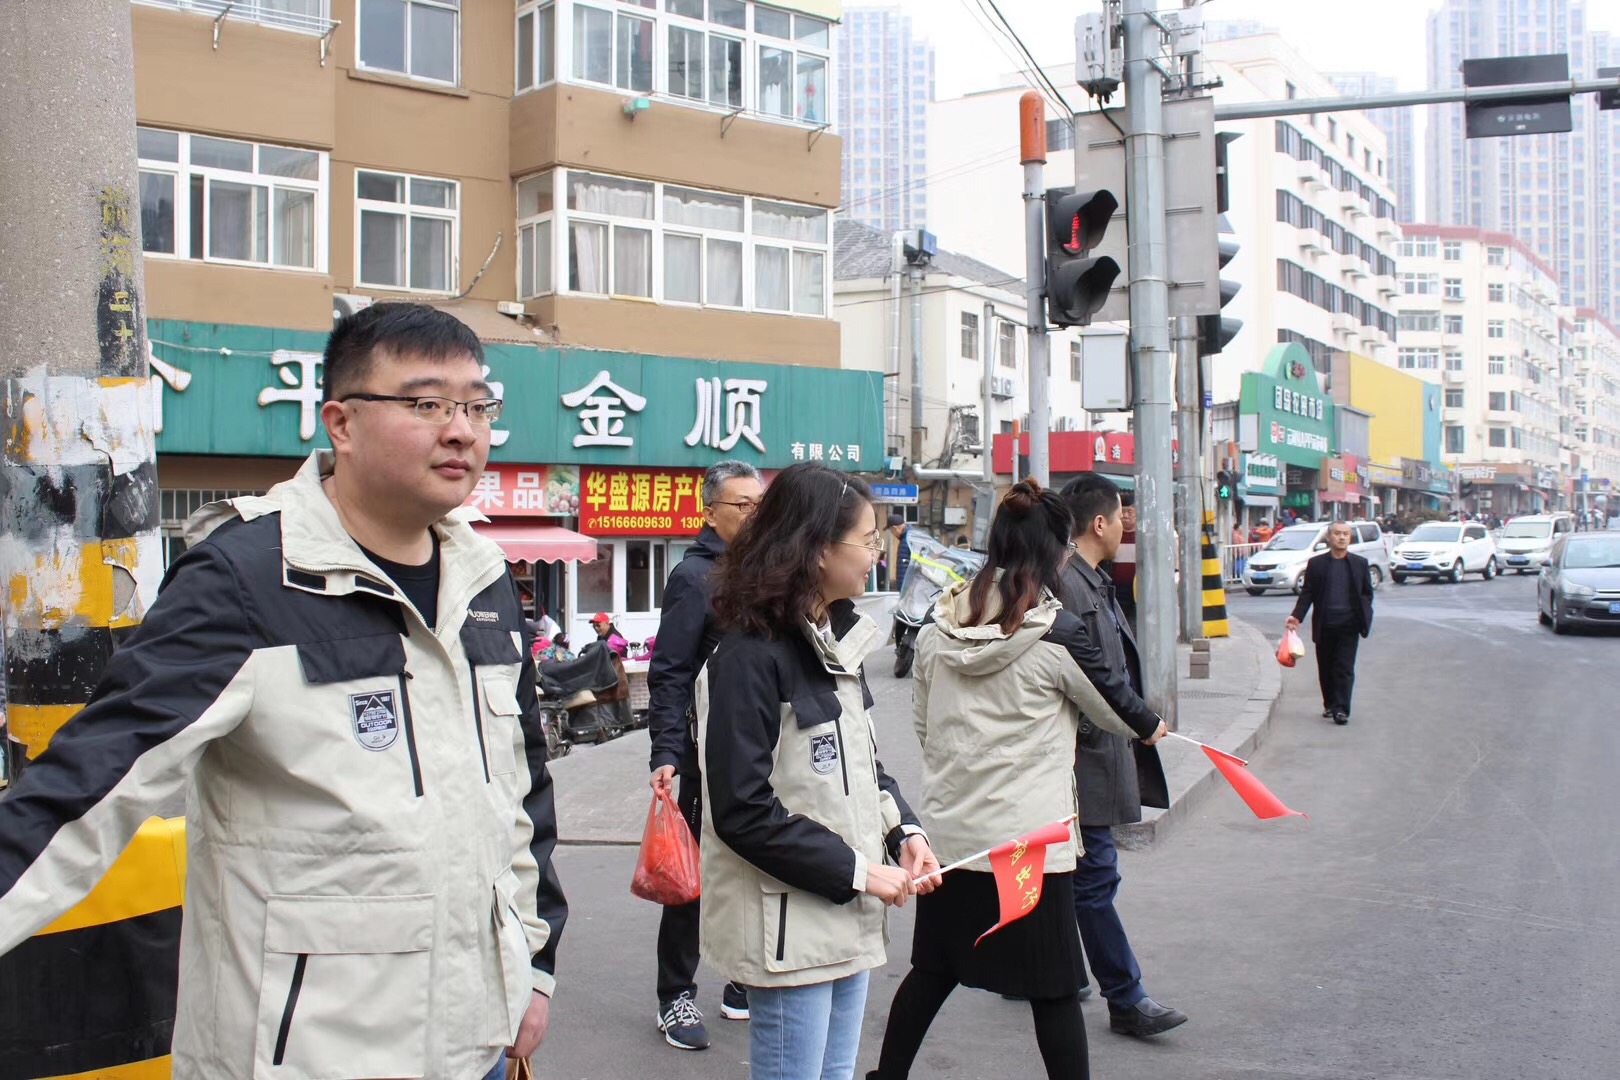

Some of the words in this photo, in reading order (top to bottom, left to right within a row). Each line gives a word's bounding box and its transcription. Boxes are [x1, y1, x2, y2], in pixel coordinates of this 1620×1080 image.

[791, 441, 860, 462] 有限公司
[471, 470, 544, 509] 果品
[597, 516, 672, 529] 15166609630
